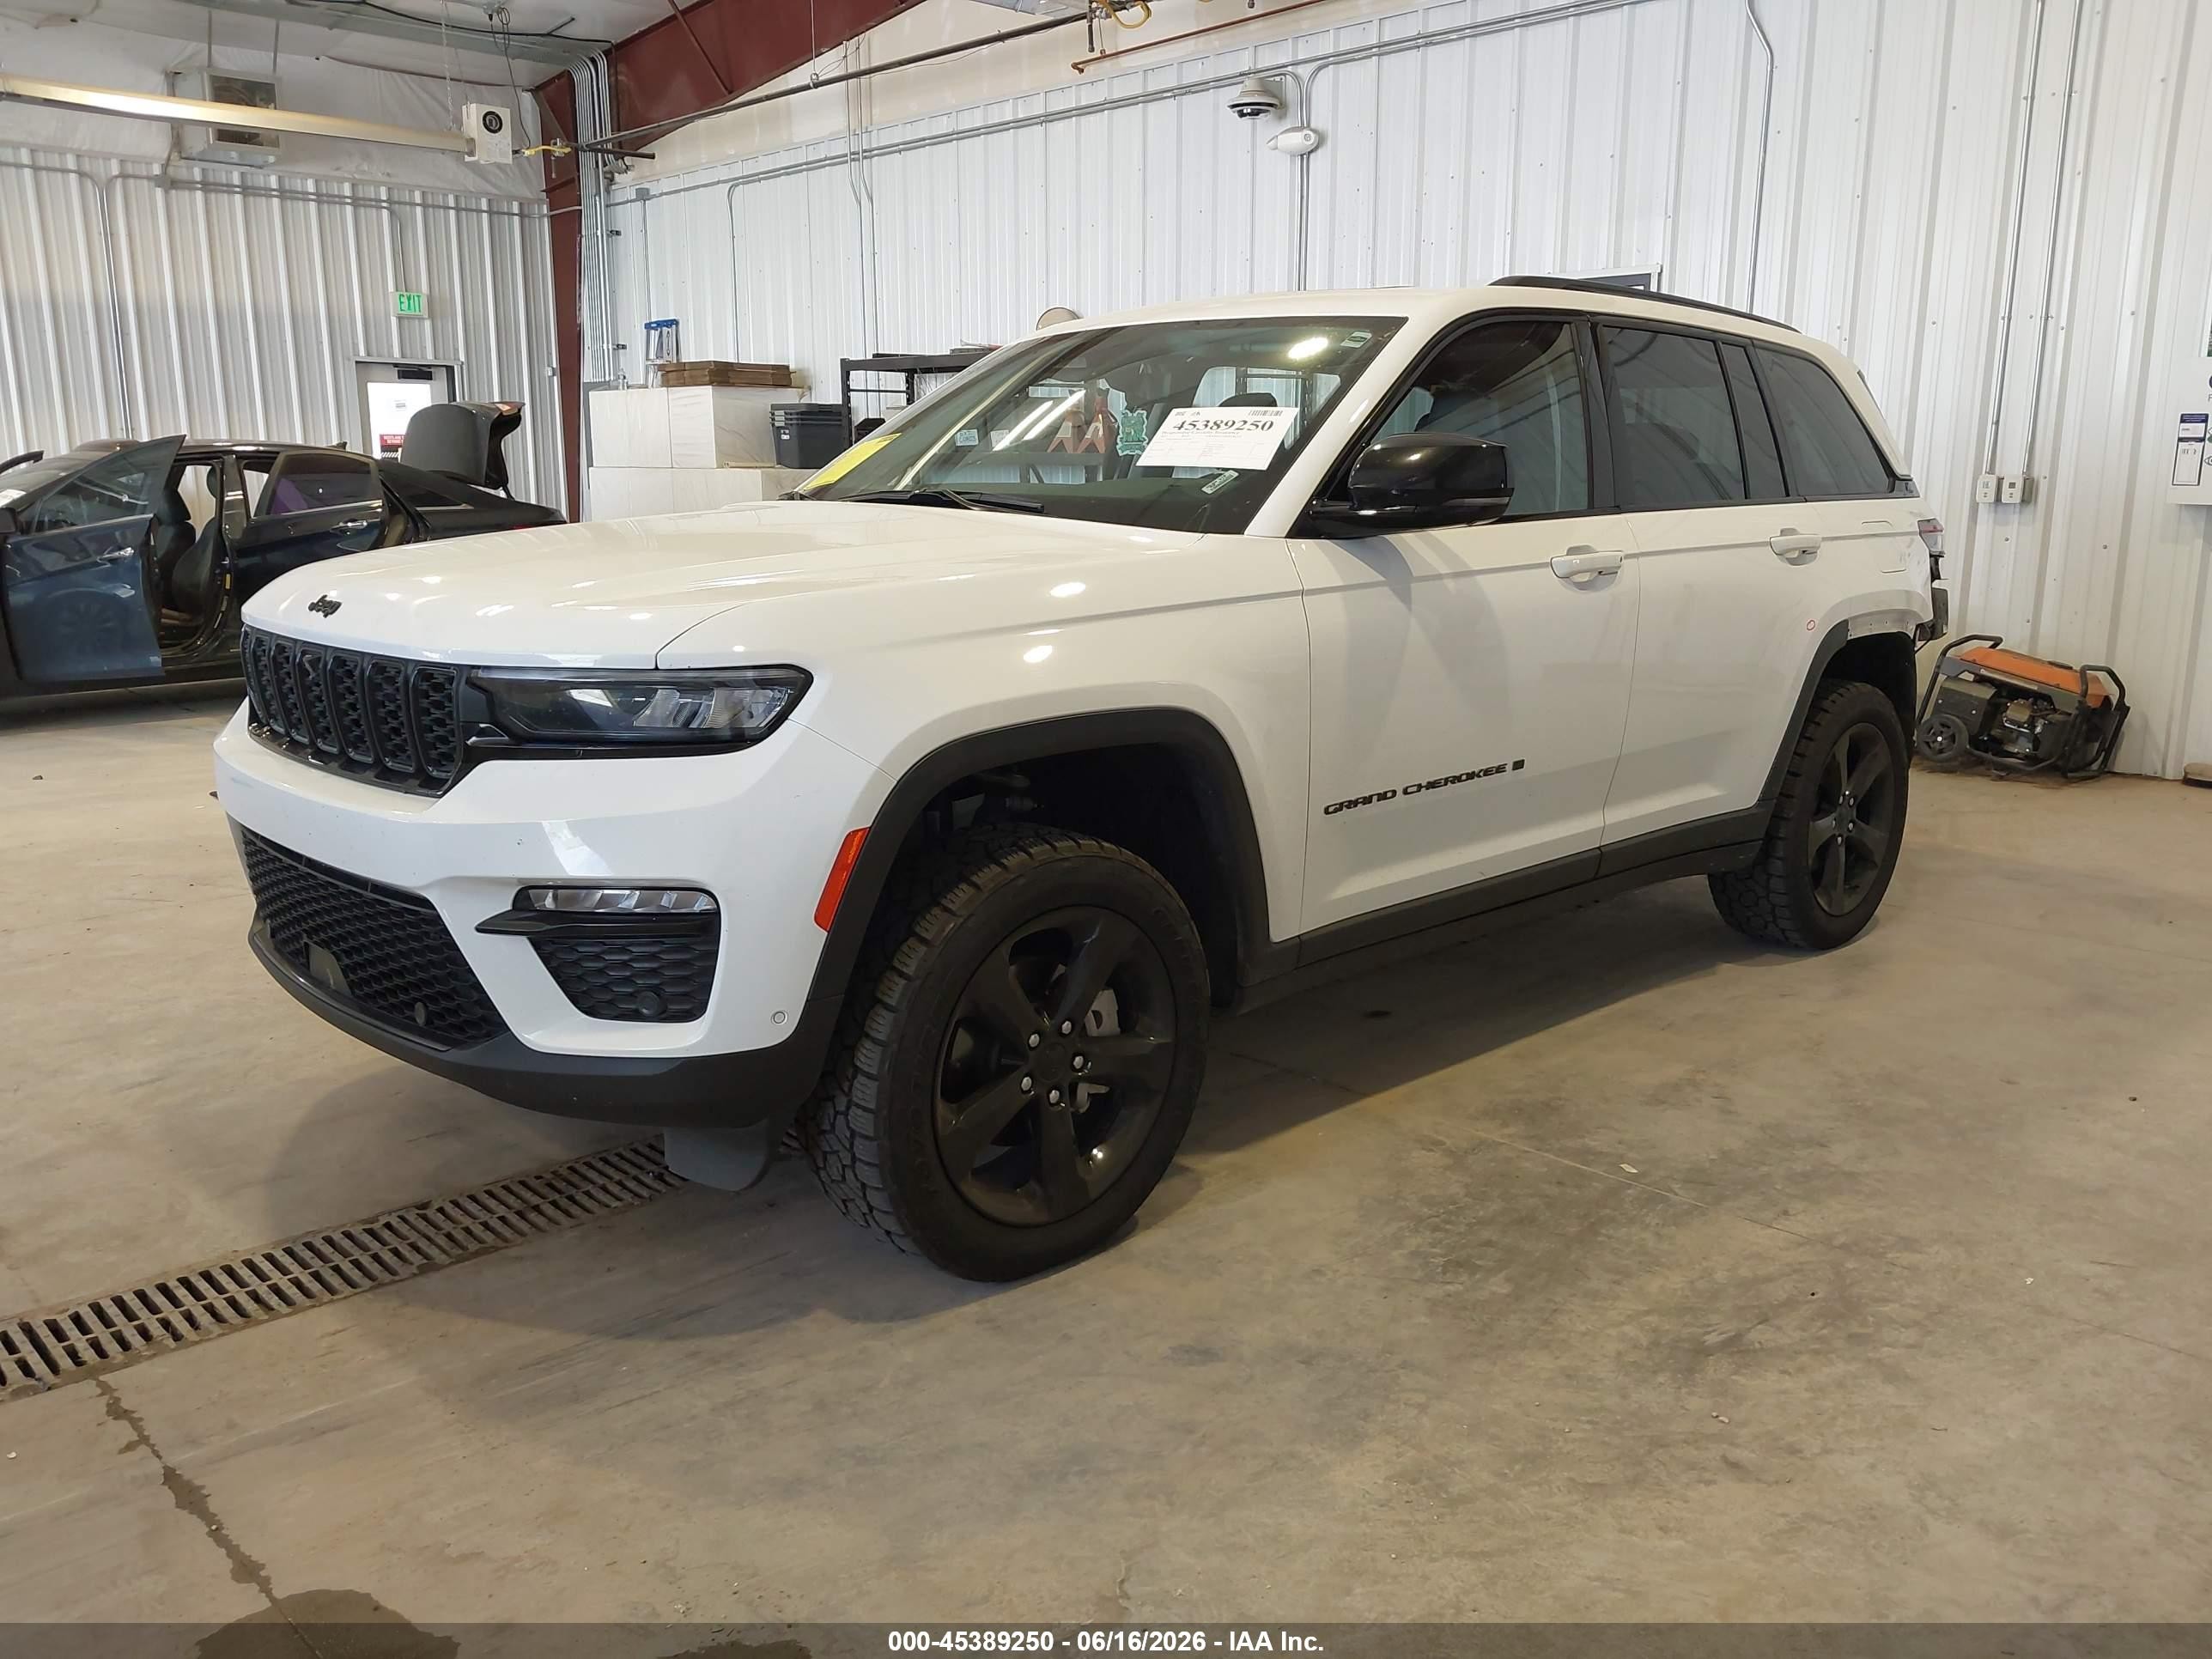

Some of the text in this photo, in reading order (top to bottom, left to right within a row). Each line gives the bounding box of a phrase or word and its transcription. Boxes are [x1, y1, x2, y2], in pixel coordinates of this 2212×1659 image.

[398, 293, 422, 313] EXIT
[1173, 419, 1274, 431] 45389250
[1323, 763, 1508, 816] GRAND CHEROKEE
